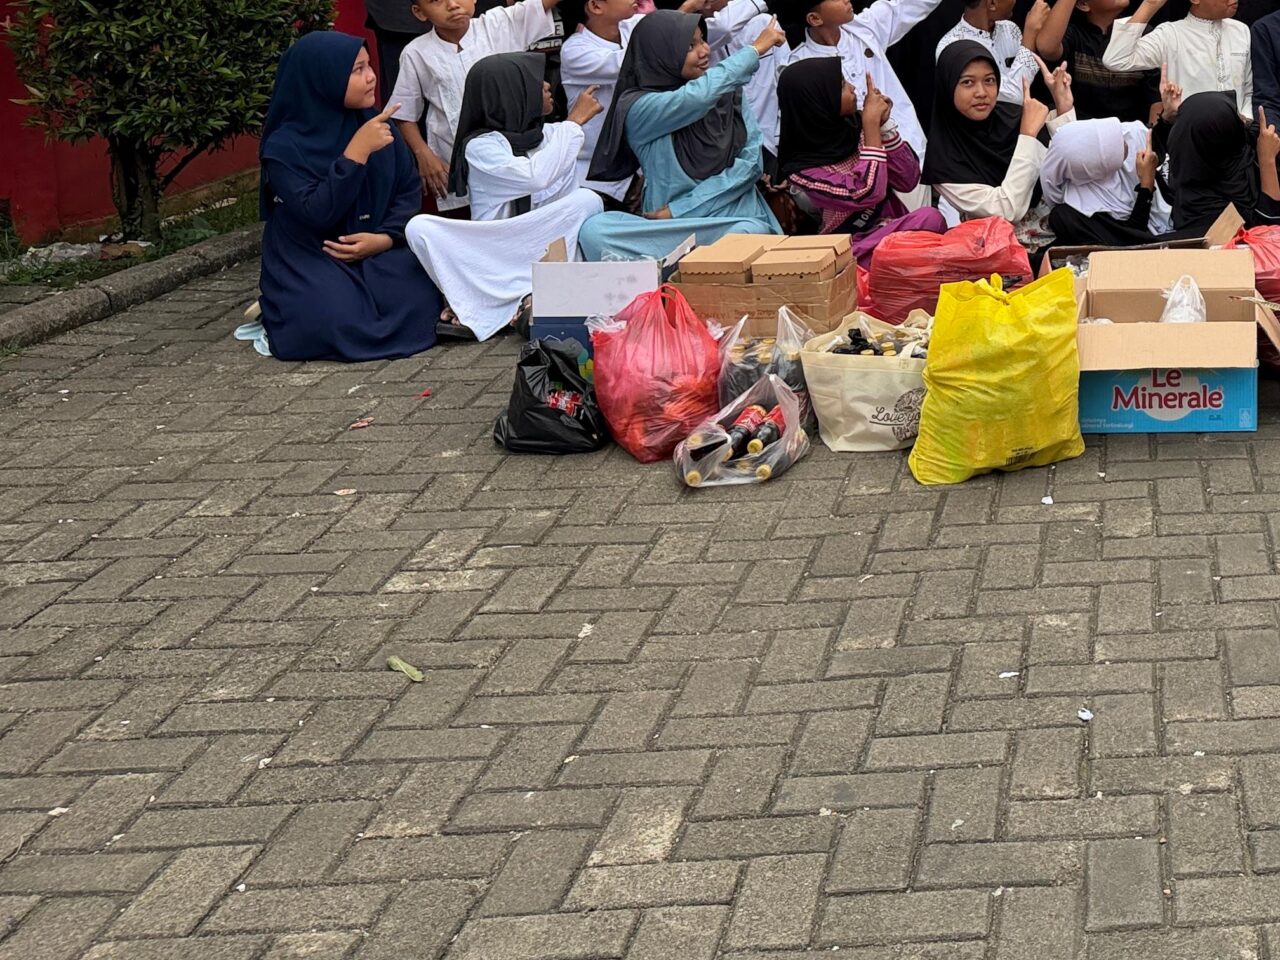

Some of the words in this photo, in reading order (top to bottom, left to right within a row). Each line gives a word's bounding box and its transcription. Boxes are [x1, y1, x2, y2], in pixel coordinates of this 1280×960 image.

[1151, 367, 1181, 388] Le
[1112, 385, 1223, 410] Minerale
[872, 406, 905, 422] Love
